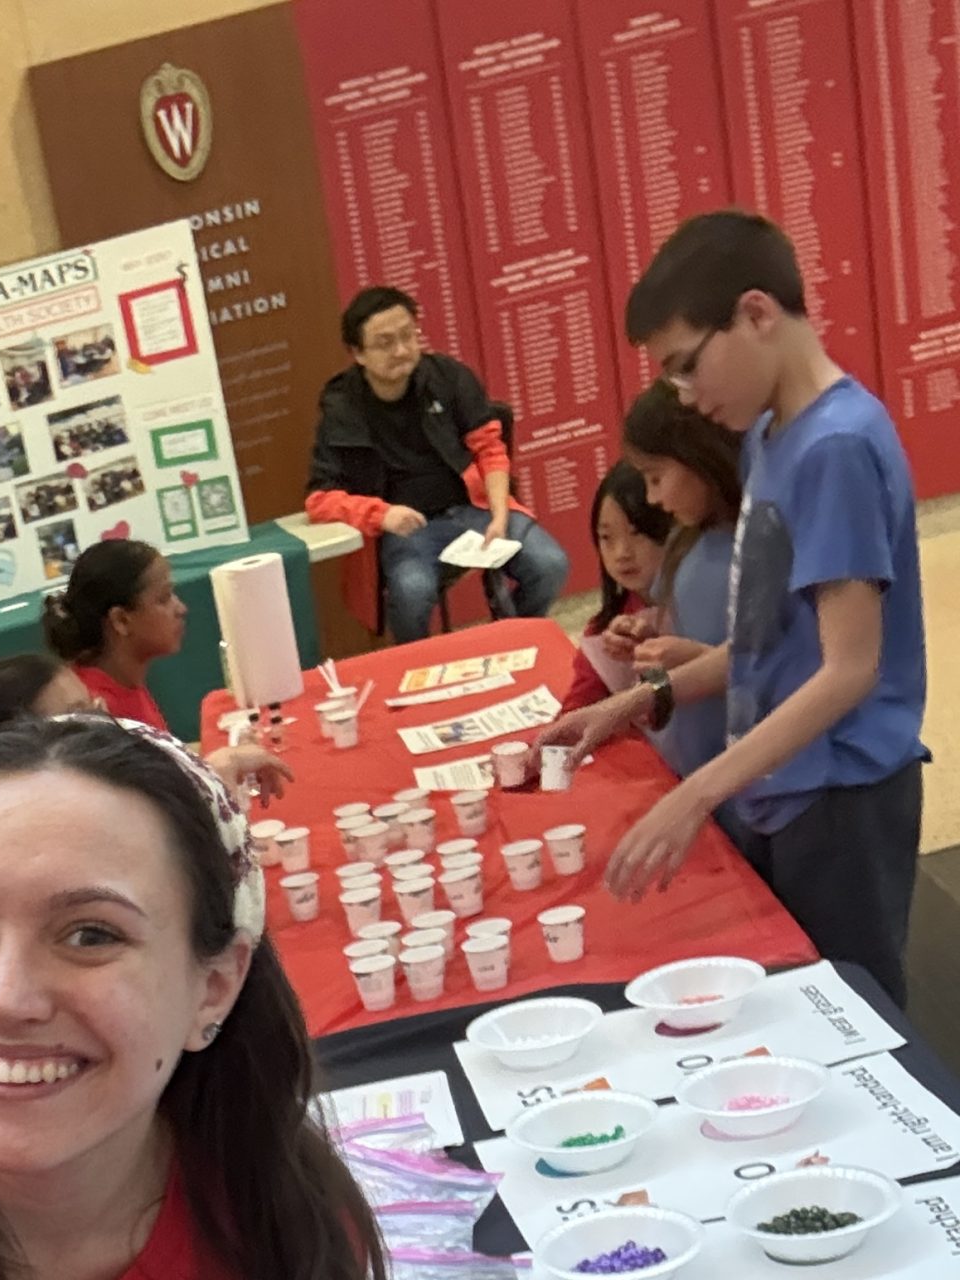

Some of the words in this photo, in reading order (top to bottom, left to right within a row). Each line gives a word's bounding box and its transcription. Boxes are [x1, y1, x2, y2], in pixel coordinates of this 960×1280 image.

[190, 199, 261, 231] ONSIN
[201, 236, 250, 262] ICAL
[206, 269, 250, 293] MNI
[209, 291, 287, 326] IATION
[799, 983, 845, 1015] glasses
[827, 1016, 861, 1037] wear
[841, 1065, 933, 1136] right-handed
